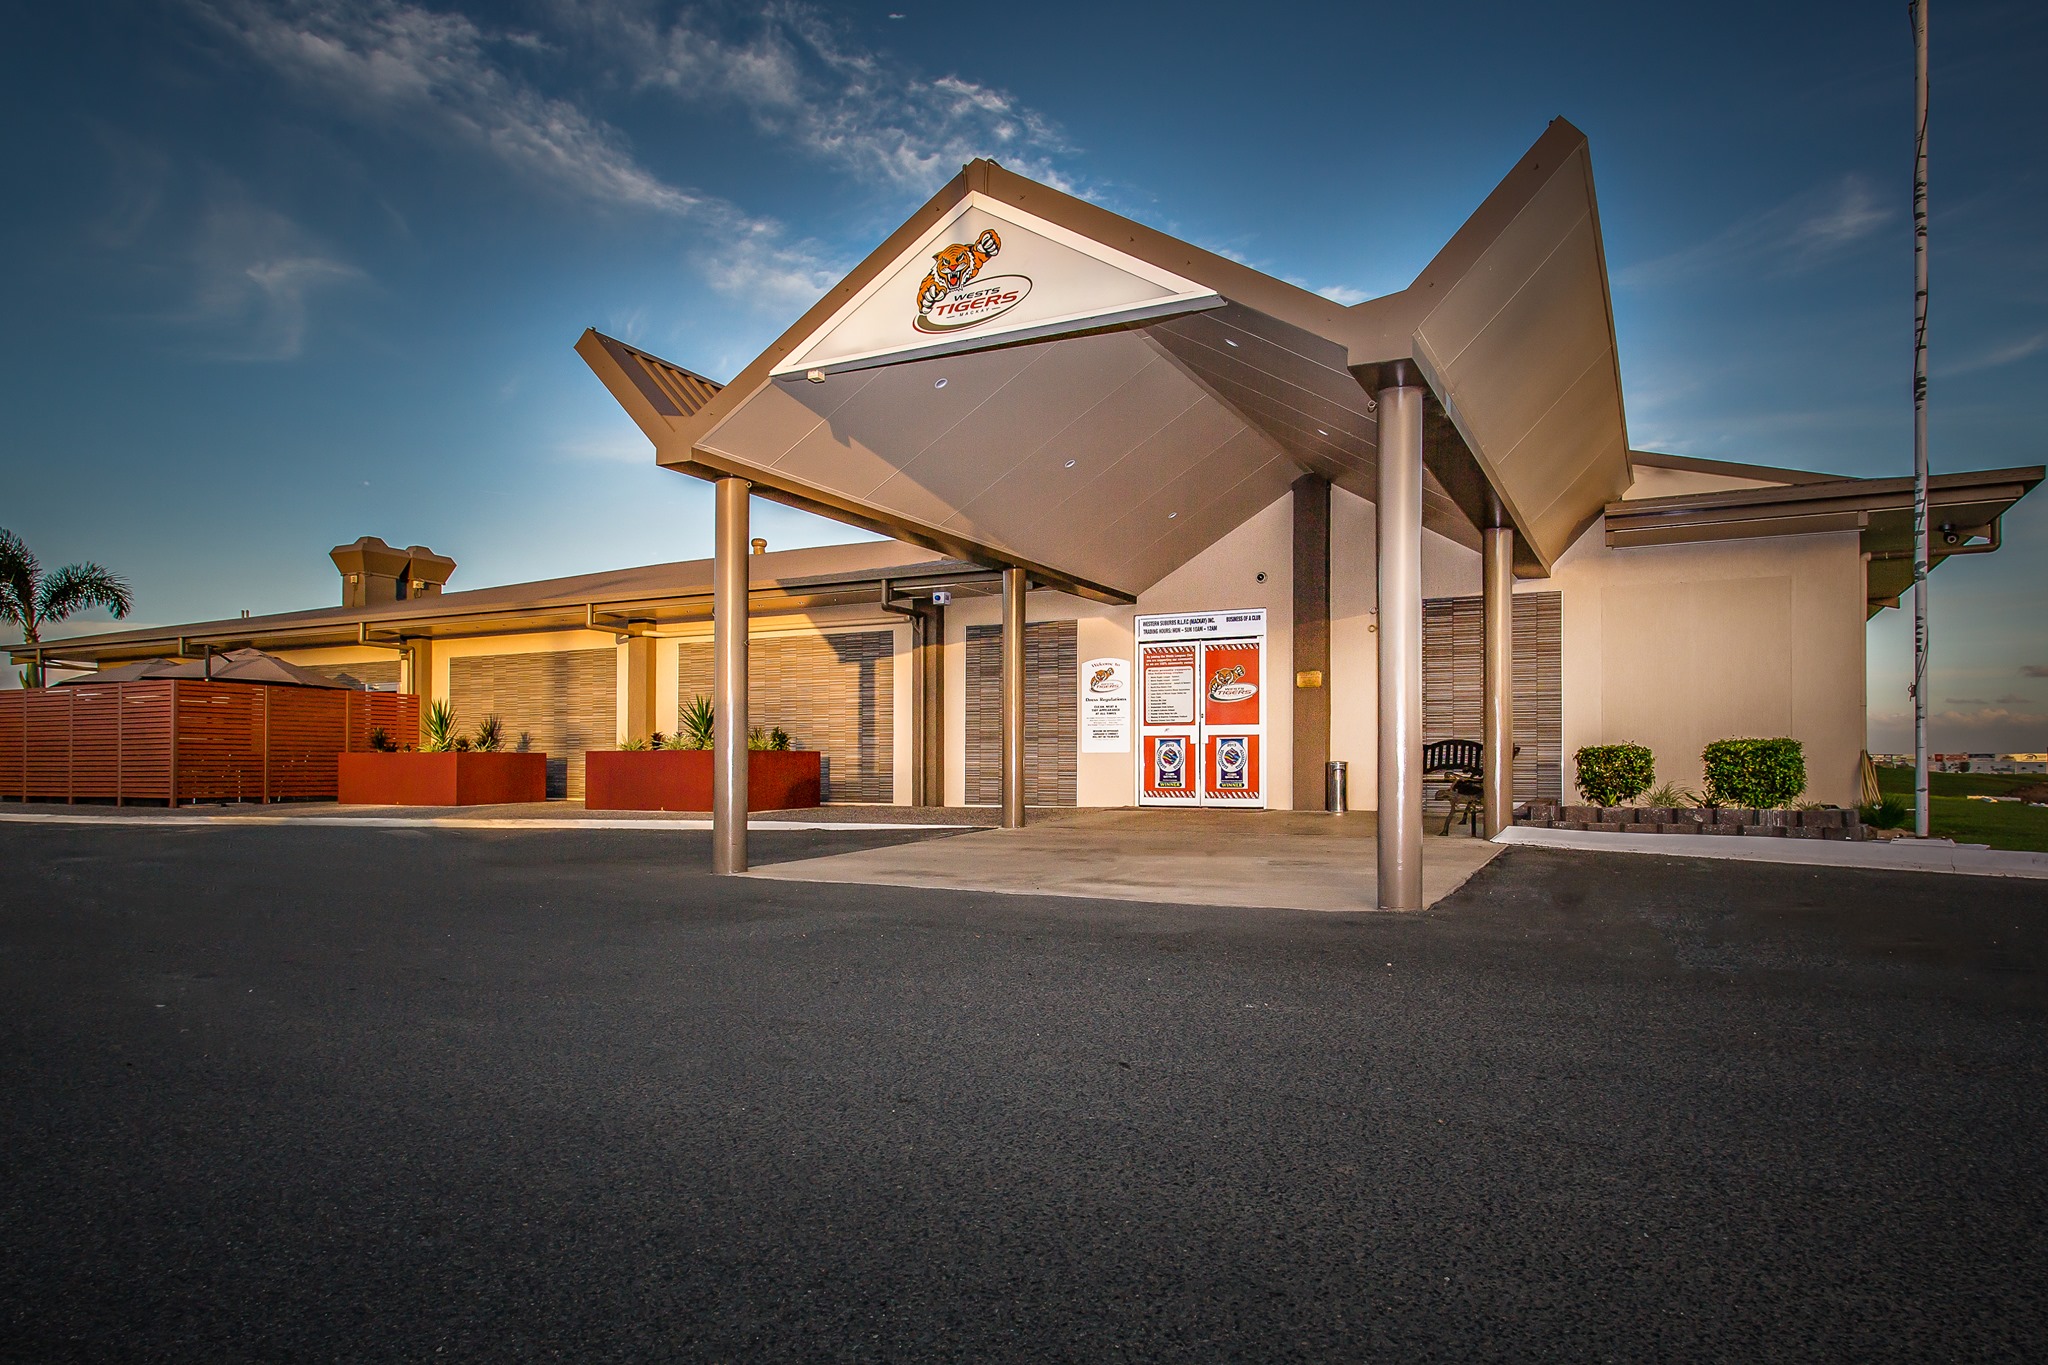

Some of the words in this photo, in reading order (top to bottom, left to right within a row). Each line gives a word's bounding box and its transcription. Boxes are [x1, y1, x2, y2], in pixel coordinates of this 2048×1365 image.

[954, 286, 1001, 302] WESTS
[936, 290, 1019, 316] TIGERS
[959, 307, 990, 317] MACKAY
